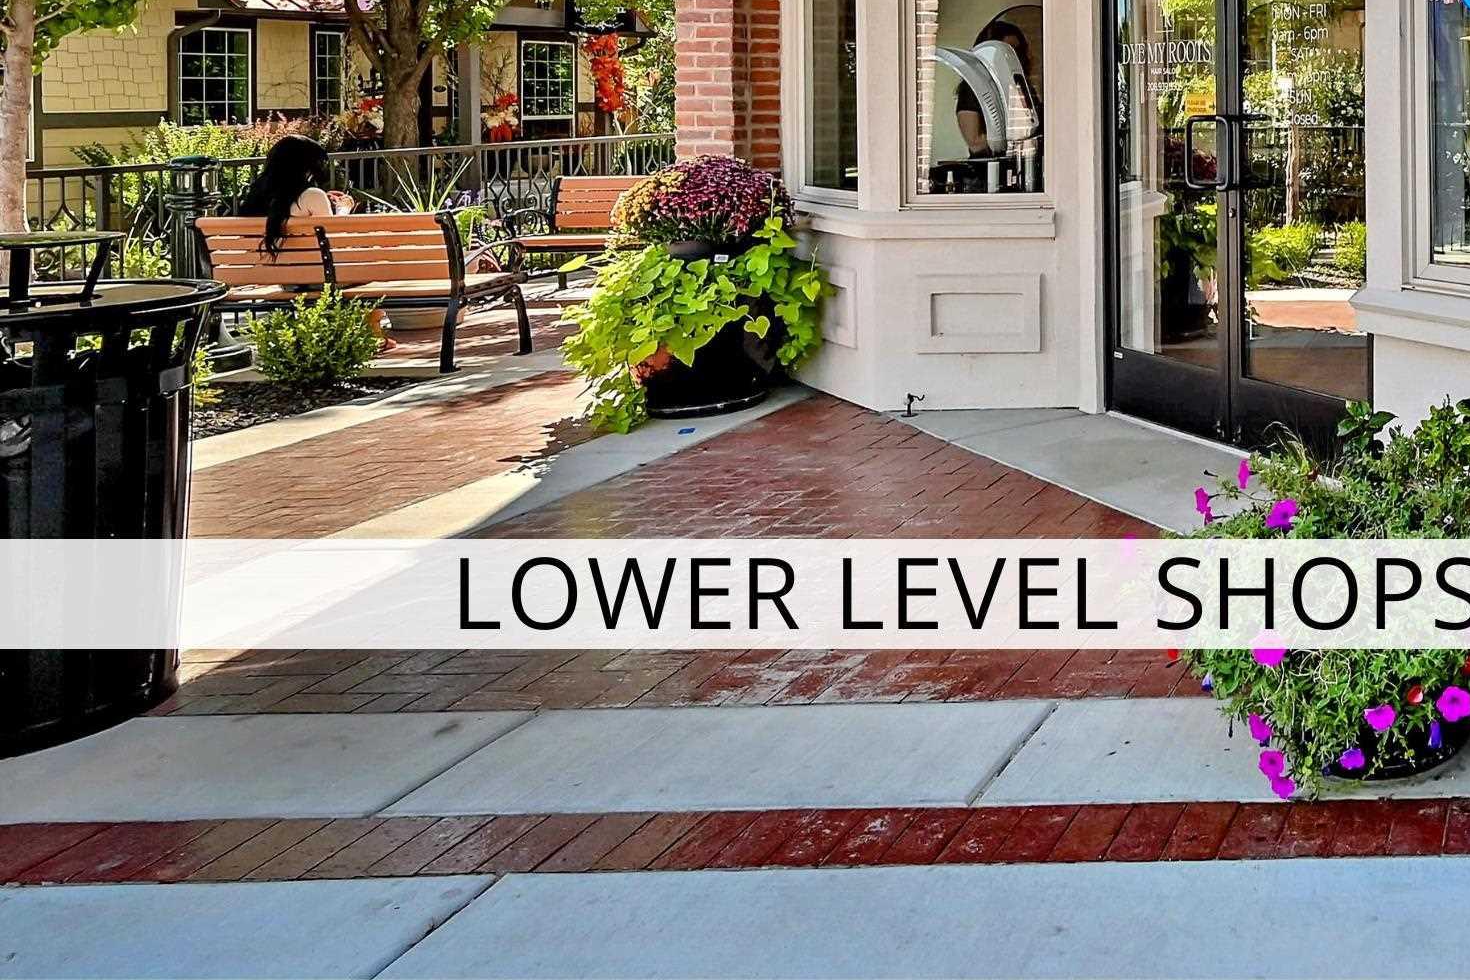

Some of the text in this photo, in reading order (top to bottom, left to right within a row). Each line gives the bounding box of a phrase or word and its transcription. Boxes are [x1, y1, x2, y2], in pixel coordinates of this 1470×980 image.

[1272, 3, 1300, 20] MON
[1309, 4, 1327, 19] FRI
[1303, 26, 1329, 42] 6pm
[1122, 40, 1211, 65] DYE MY ROOTS
[1291, 46, 1310, 62] SAT
[1289, 88, 1313, 104] SUN
